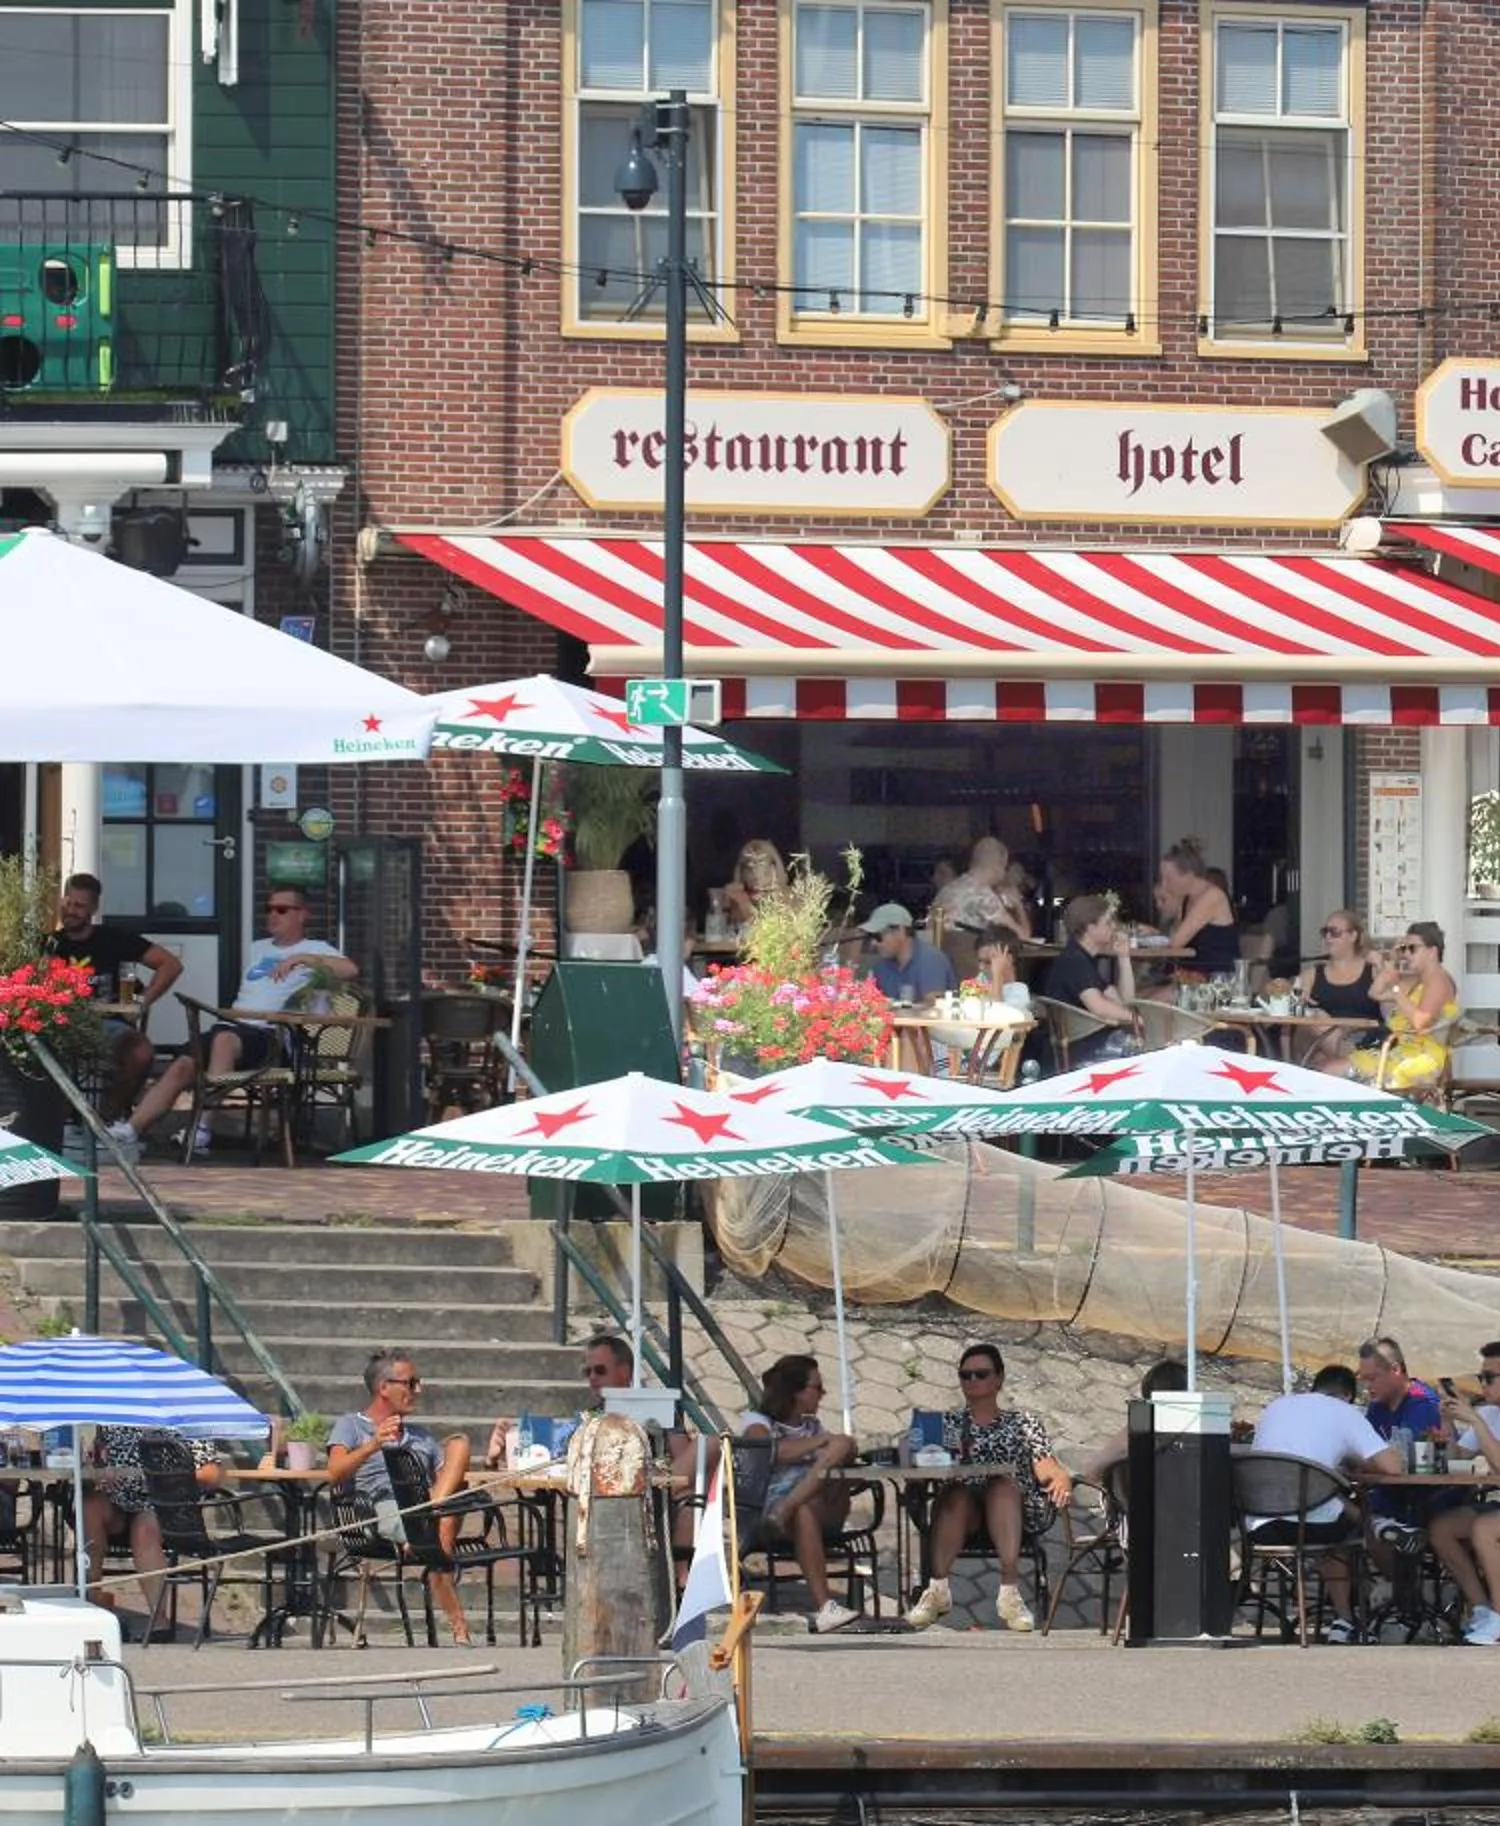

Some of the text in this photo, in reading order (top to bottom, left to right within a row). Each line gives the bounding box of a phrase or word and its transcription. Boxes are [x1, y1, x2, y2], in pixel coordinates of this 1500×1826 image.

[611, 420, 909, 476] restaurant
[1116, 428, 1246, 499] hotel
[333, 736, 417, 754] Heineken
[930, 1105, 1131, 1134] Heineken
[1161, 1103, 1438, 1130] Heineken
[367, 1139, 596, 1181] Heineken
[627, 1145, 897, 1182] Heineken
